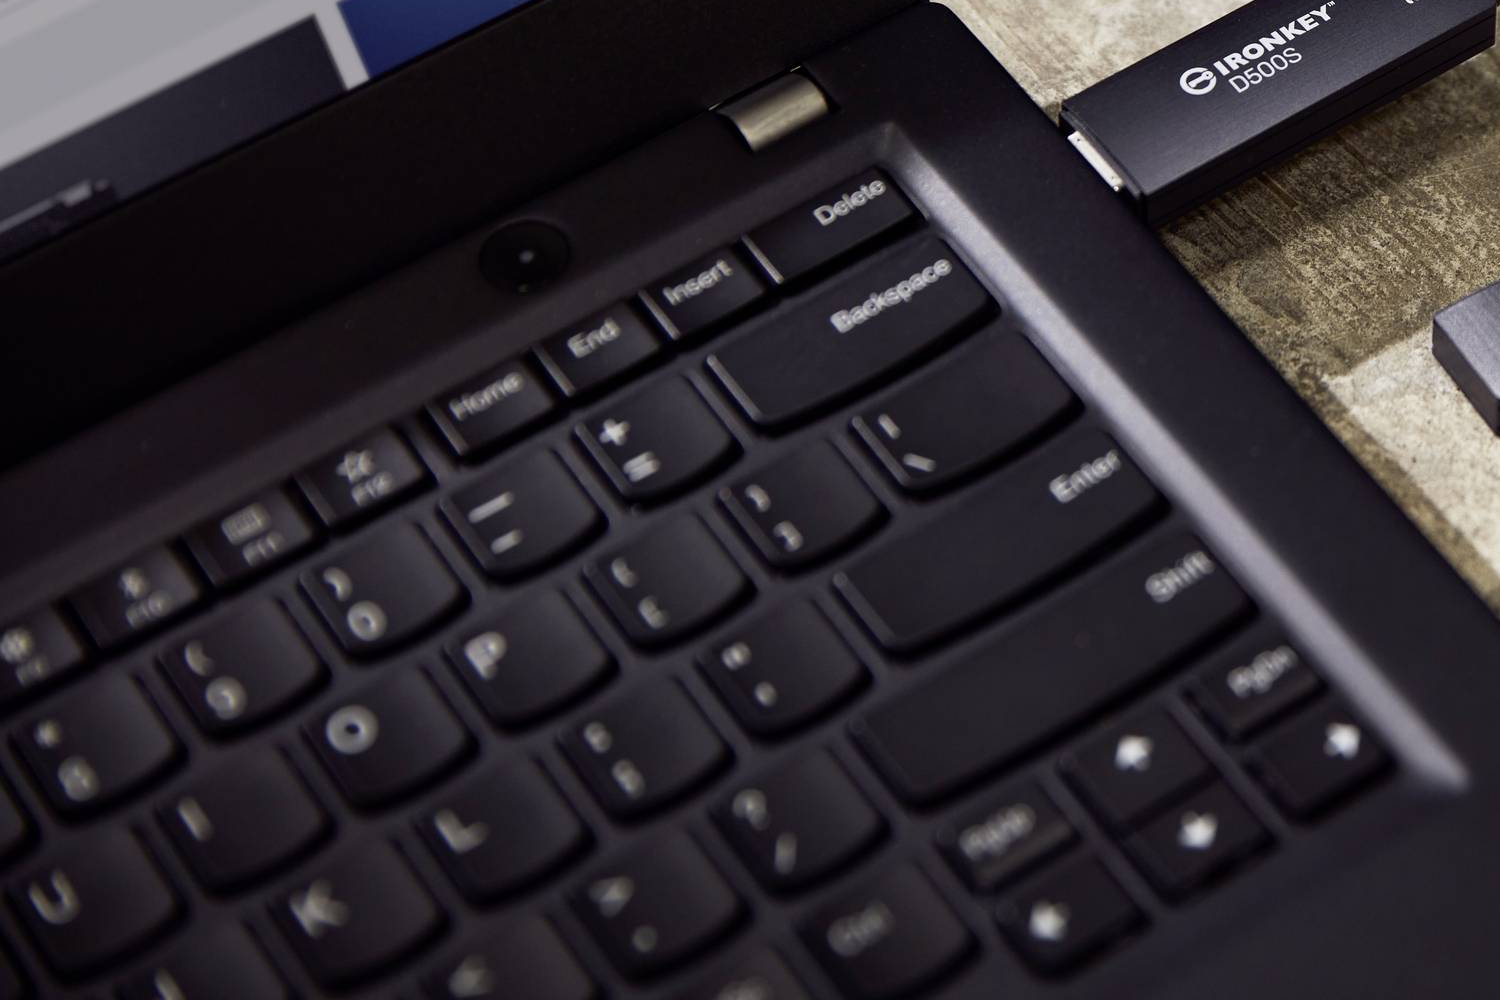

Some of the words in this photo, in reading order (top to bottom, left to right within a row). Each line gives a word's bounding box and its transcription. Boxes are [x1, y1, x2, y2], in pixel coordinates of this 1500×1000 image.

[1228, 47, 1303, 93] D500S
[812, 178, 888, 227] Delete
[662, 258, 734, 306] Insert
[829, 257, 953, 335] Backspace
[567, 316, 622, 360] End
[448, 370, 524, 420] Home
[1048, 450, 1121, 503] Enter
[1145, 552, 1216, 603] Shift
[464, 630, 508, 681] P
[325, 704, 379, 754] O
[434, 808, 489, 854] L
[29, 868, 82, 925] U
[289, 879, 351, 940] K
